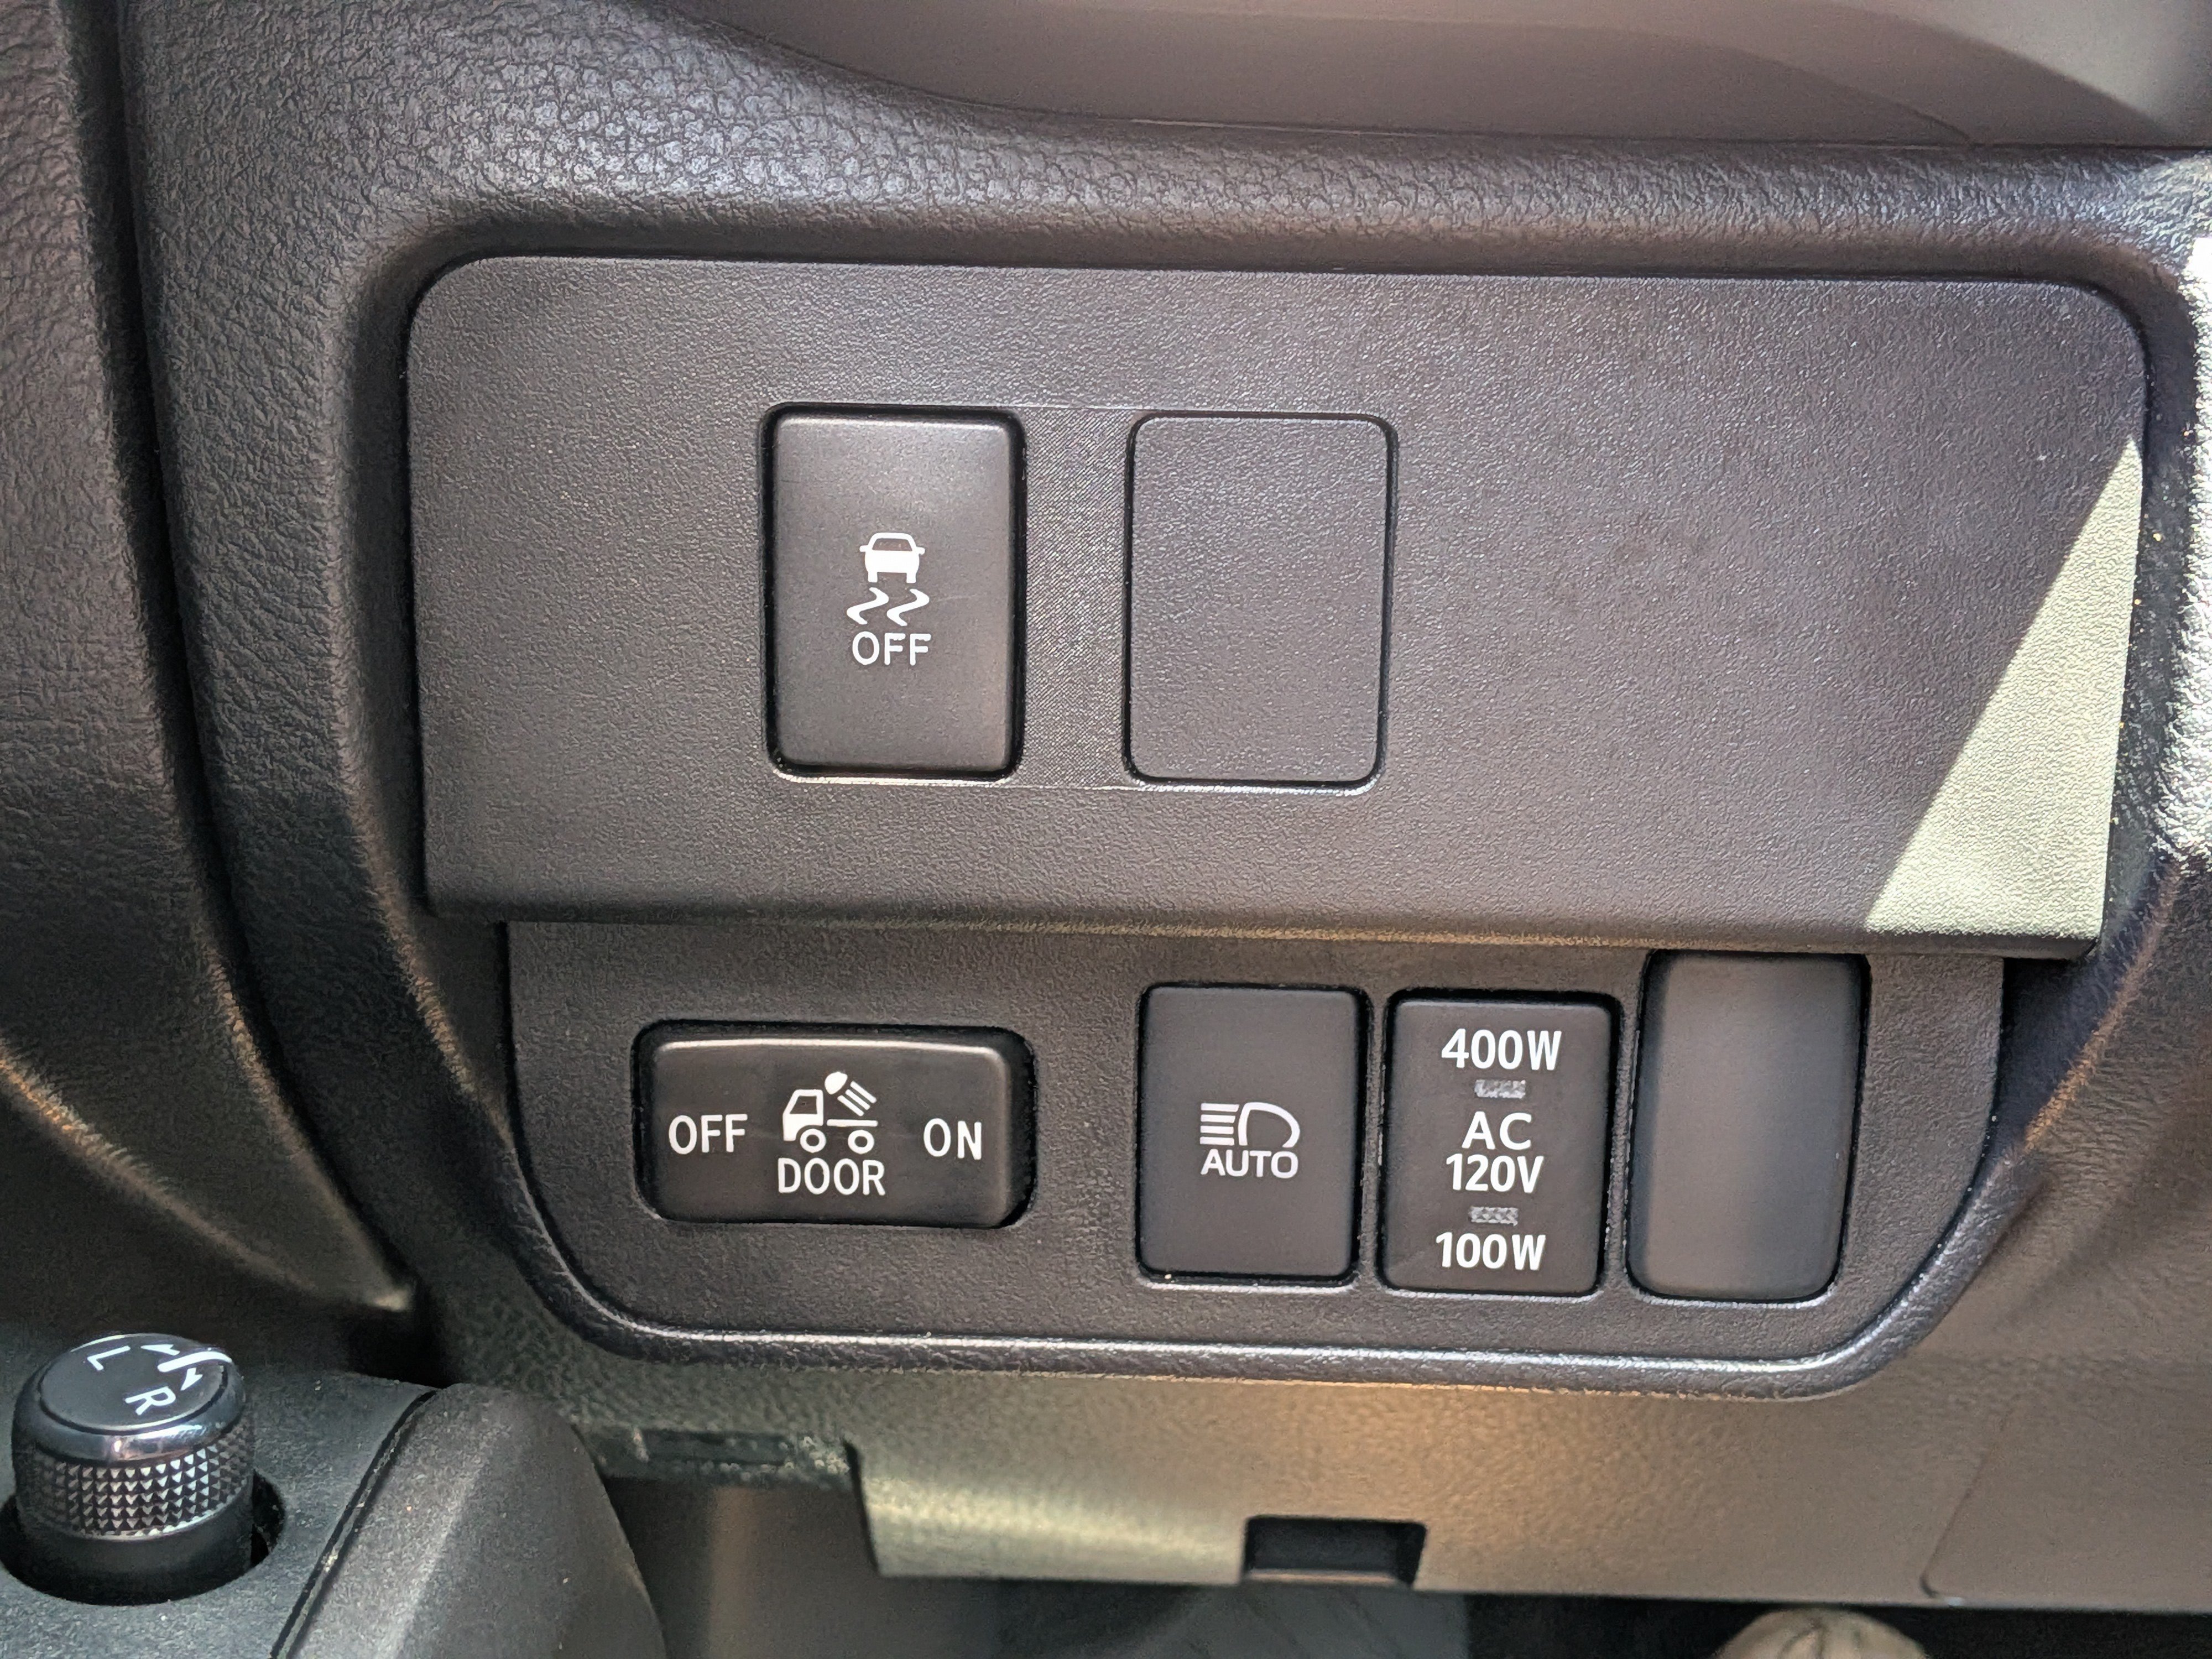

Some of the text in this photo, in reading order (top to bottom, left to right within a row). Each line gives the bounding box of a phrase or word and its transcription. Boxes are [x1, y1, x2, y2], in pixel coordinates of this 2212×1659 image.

[852, 631, 931, 666] OFF
[1441, 1028, 1562, 1071] 400W
[669, 1113, 748, 1155] OFF
[924, 1118, 982, 1160] ON
[1462, 1111, 1532, 1150] AC
[778, 1157, 885, 1196] DOOR
[1201, 1149, 1298, 1178] AUTO
[1446, 1153, 1544, 1193] 120V
[1436, 1232, 1546, 1271] 100W
[87, 1345, 131, 1371] L
[124, 1386, 176, 1416] R
